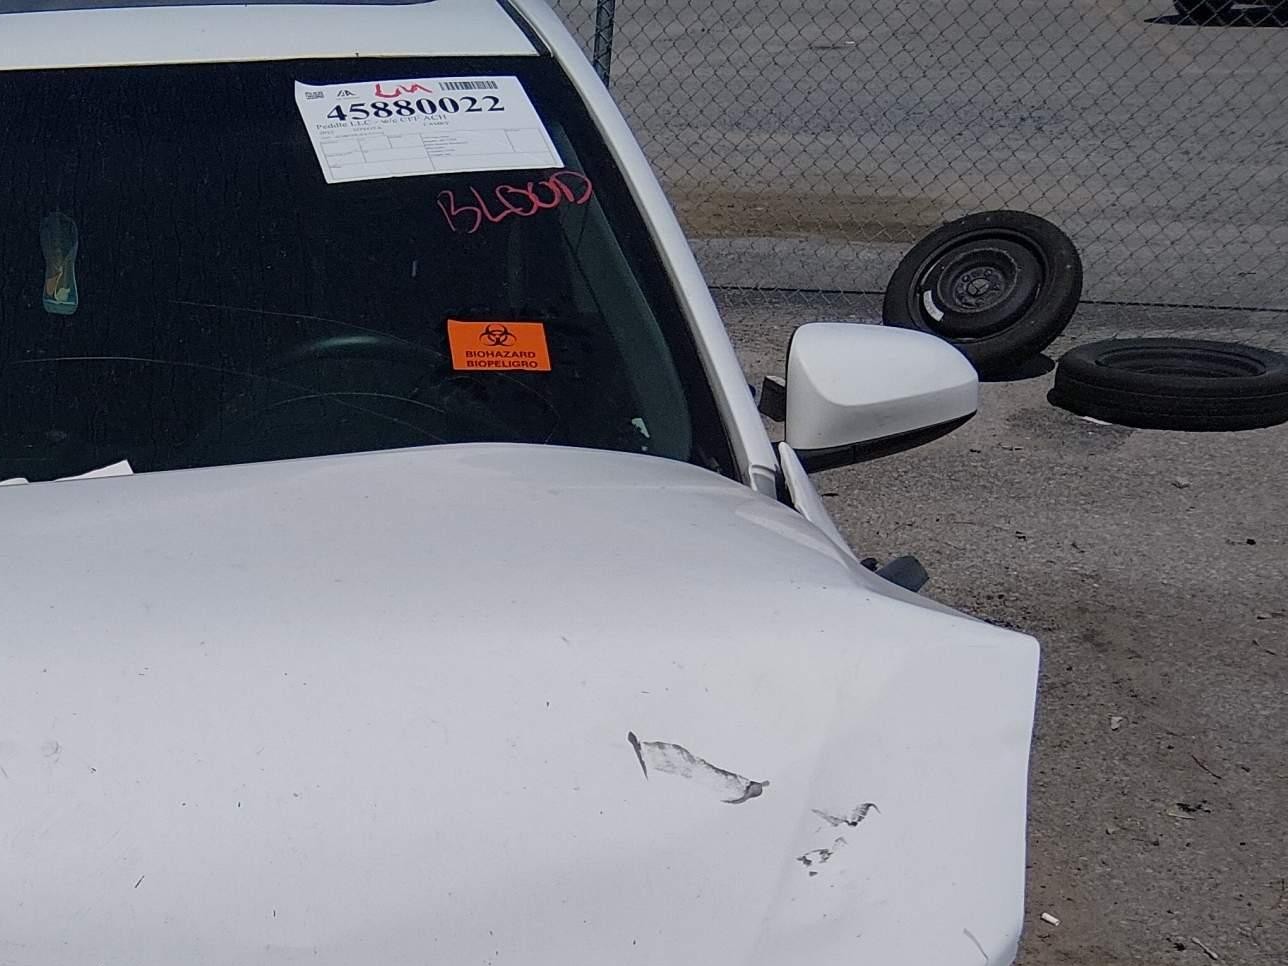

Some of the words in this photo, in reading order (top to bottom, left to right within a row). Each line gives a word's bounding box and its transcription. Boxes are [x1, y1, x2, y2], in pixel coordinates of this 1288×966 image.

[326, 95, 505, 121] 45880022
[437, 171, 593, 234] BLOOD
[465, 350, 536, 359] BIOHAZARD
[466, 359, 538, 369] BIOPELIGRO
